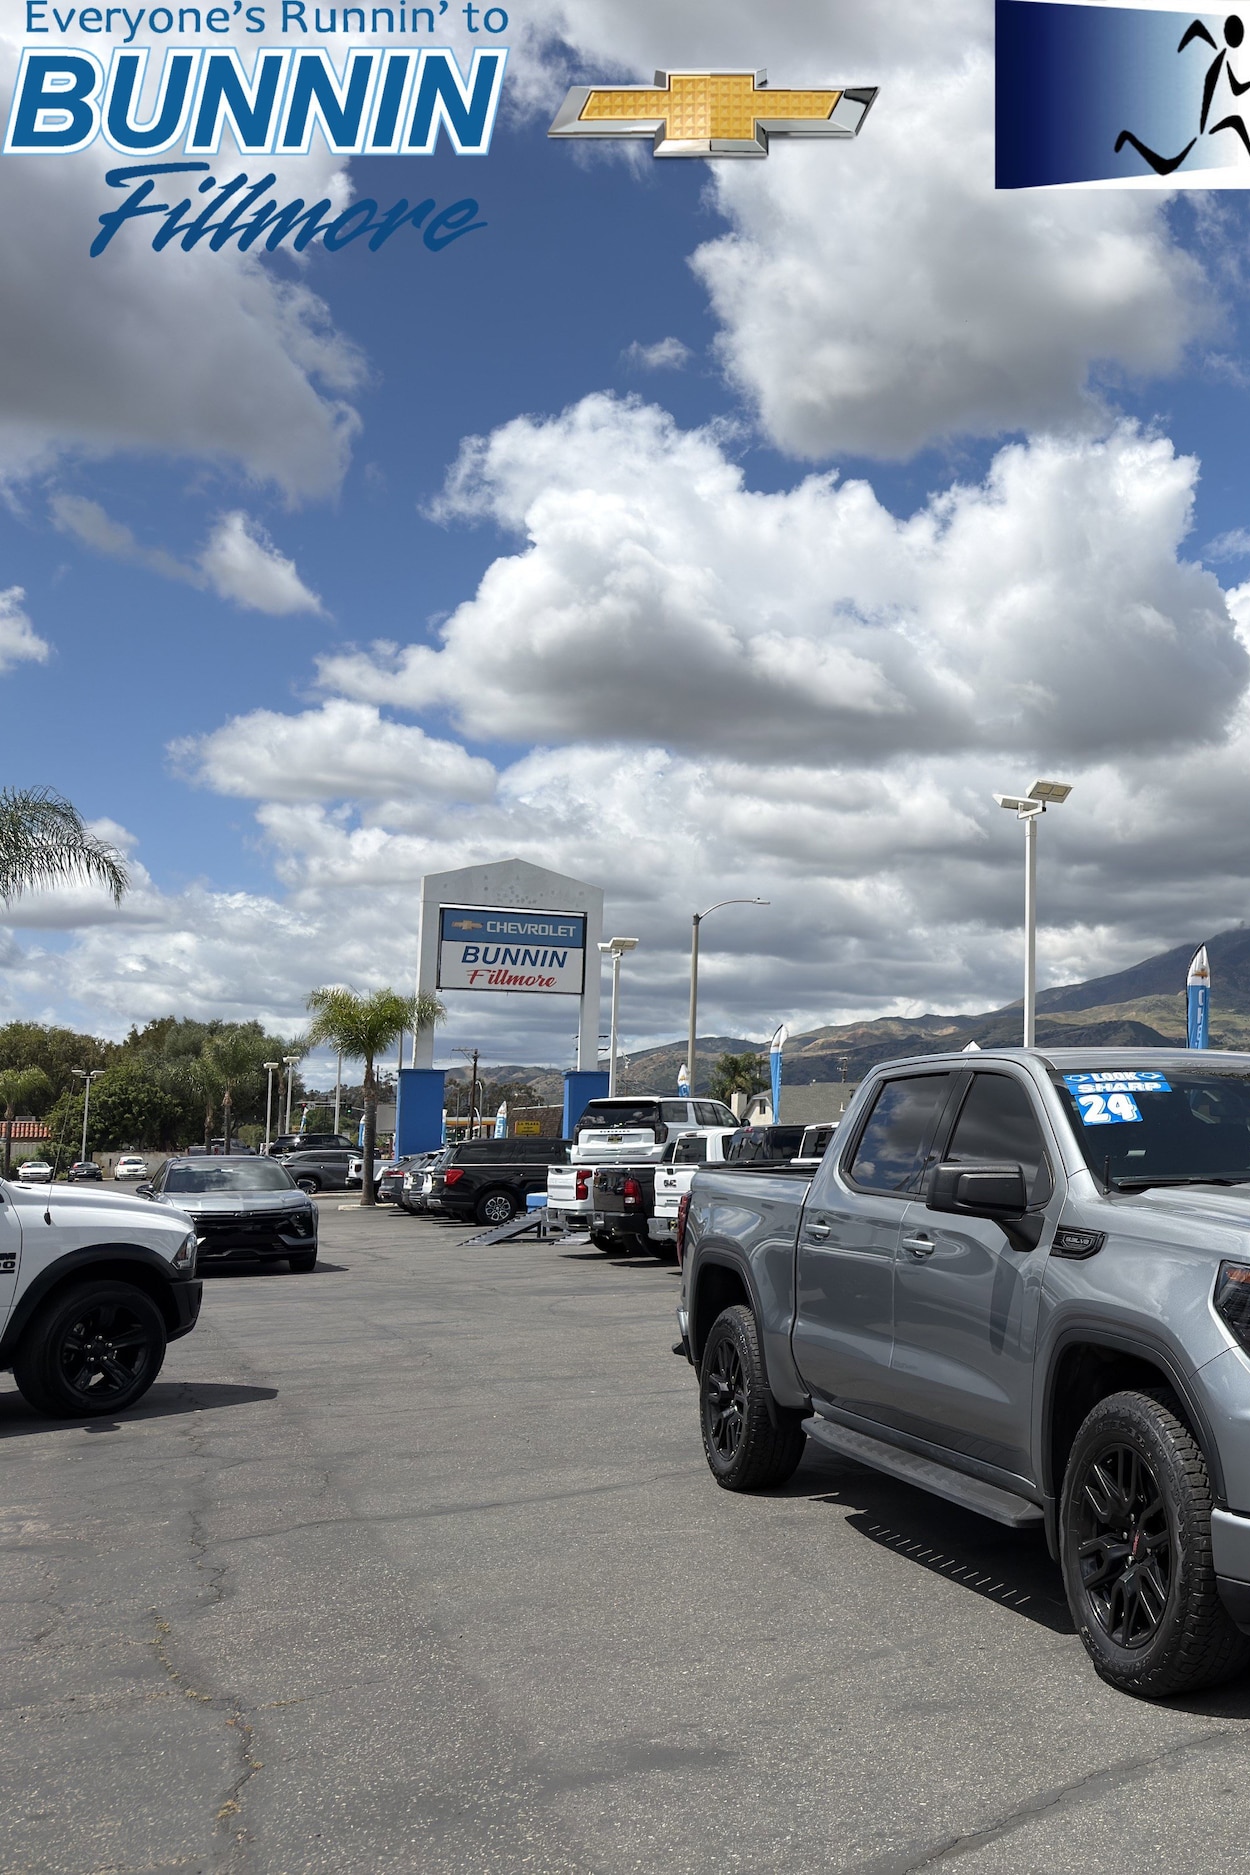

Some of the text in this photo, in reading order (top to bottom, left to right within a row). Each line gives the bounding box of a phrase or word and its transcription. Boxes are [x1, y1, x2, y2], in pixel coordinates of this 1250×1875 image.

[486, 920, 576, 937] CHEVROLET
[461, 945, 568, 969] BUNNIN
[466, 969, 557, 987] Fillmore
[1090, 1071, 1140, 1082] LOOK
[1077, 1082, 1162, 1093] SHARP
[1079, 1093, 1138, 1123] 24
